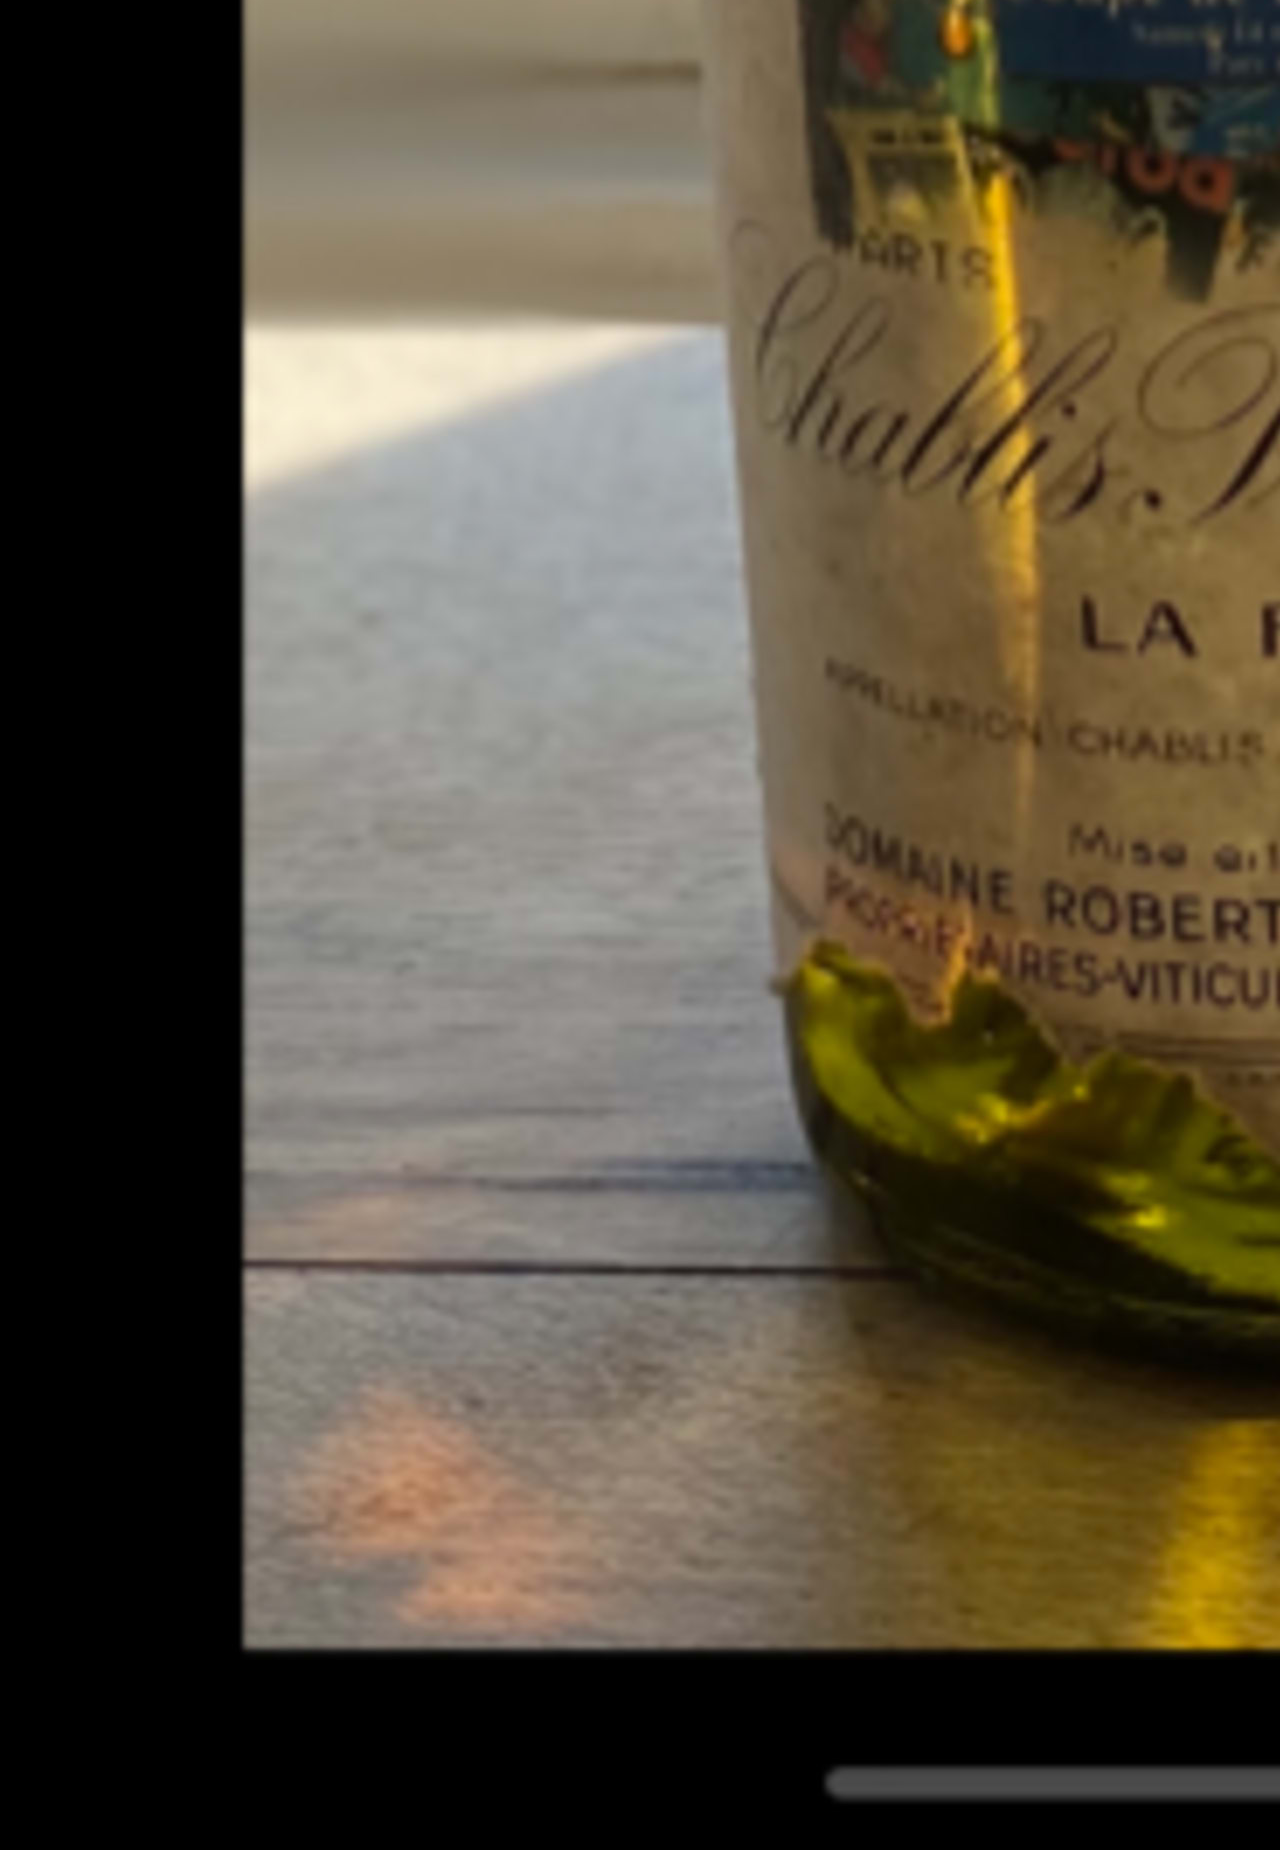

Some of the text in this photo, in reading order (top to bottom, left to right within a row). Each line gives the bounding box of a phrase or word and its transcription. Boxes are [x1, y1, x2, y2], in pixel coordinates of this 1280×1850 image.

[755, 254, 1118, 526] Chablis
[1079, 595, 1198, 658] LA
[1067, 719, 1266, 767] CHABLIS
[825, 801, 1016, 916] DOMAINE
[1069, 822, 1188, 868] Mise
